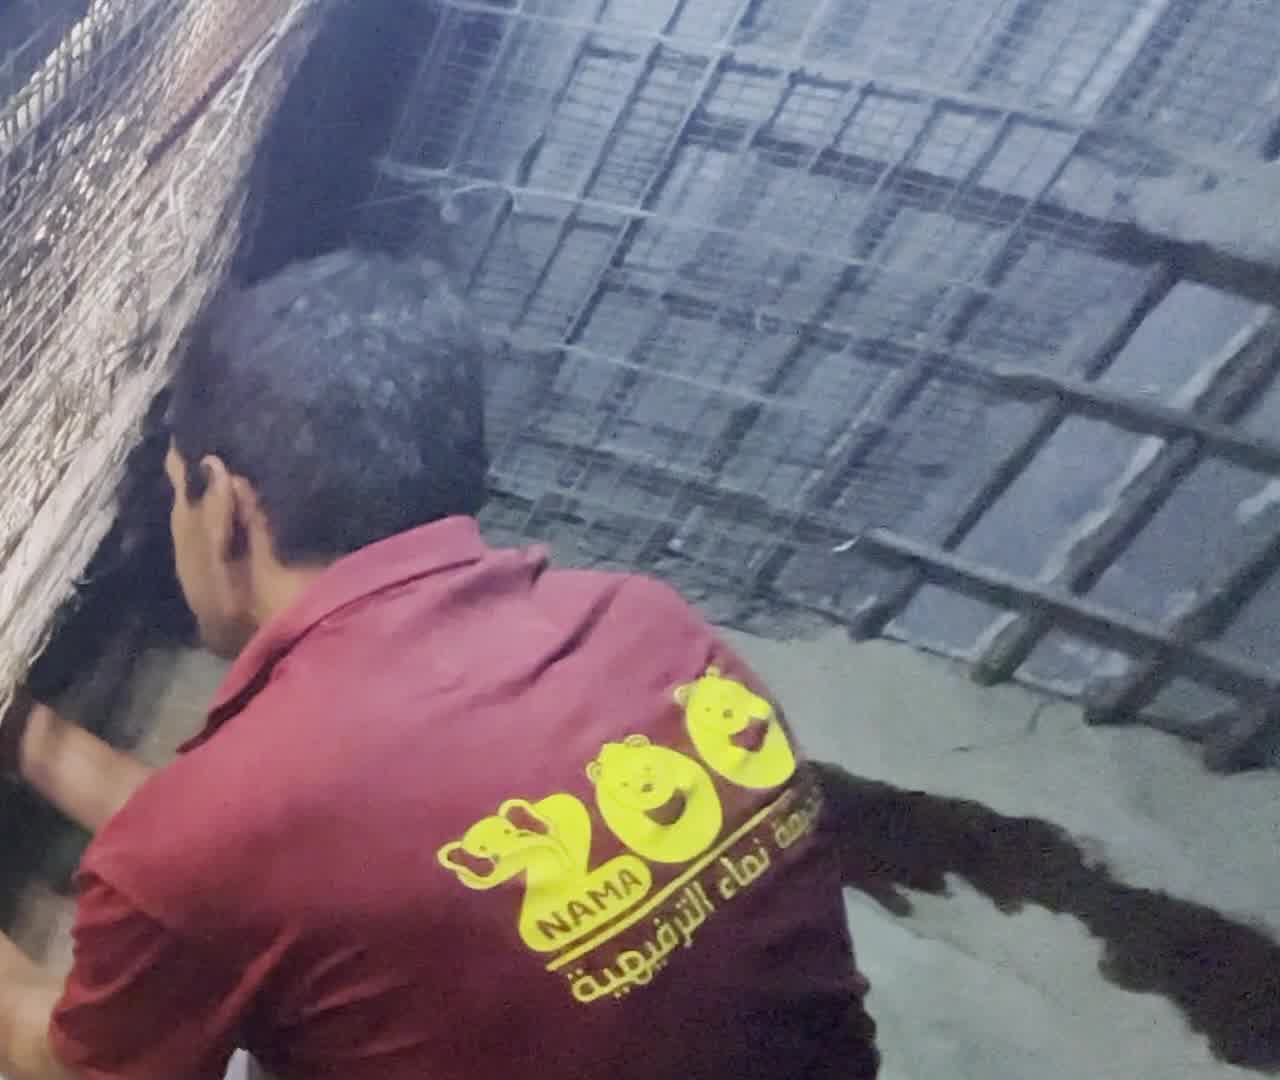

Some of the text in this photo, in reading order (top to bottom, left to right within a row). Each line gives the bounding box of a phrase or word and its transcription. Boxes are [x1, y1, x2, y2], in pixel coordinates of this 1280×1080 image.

[536, 868, 643, 940] NAMA
[719, 837, 770, 900] نماء
[566, 880, 715, 1003] الترفيهية
